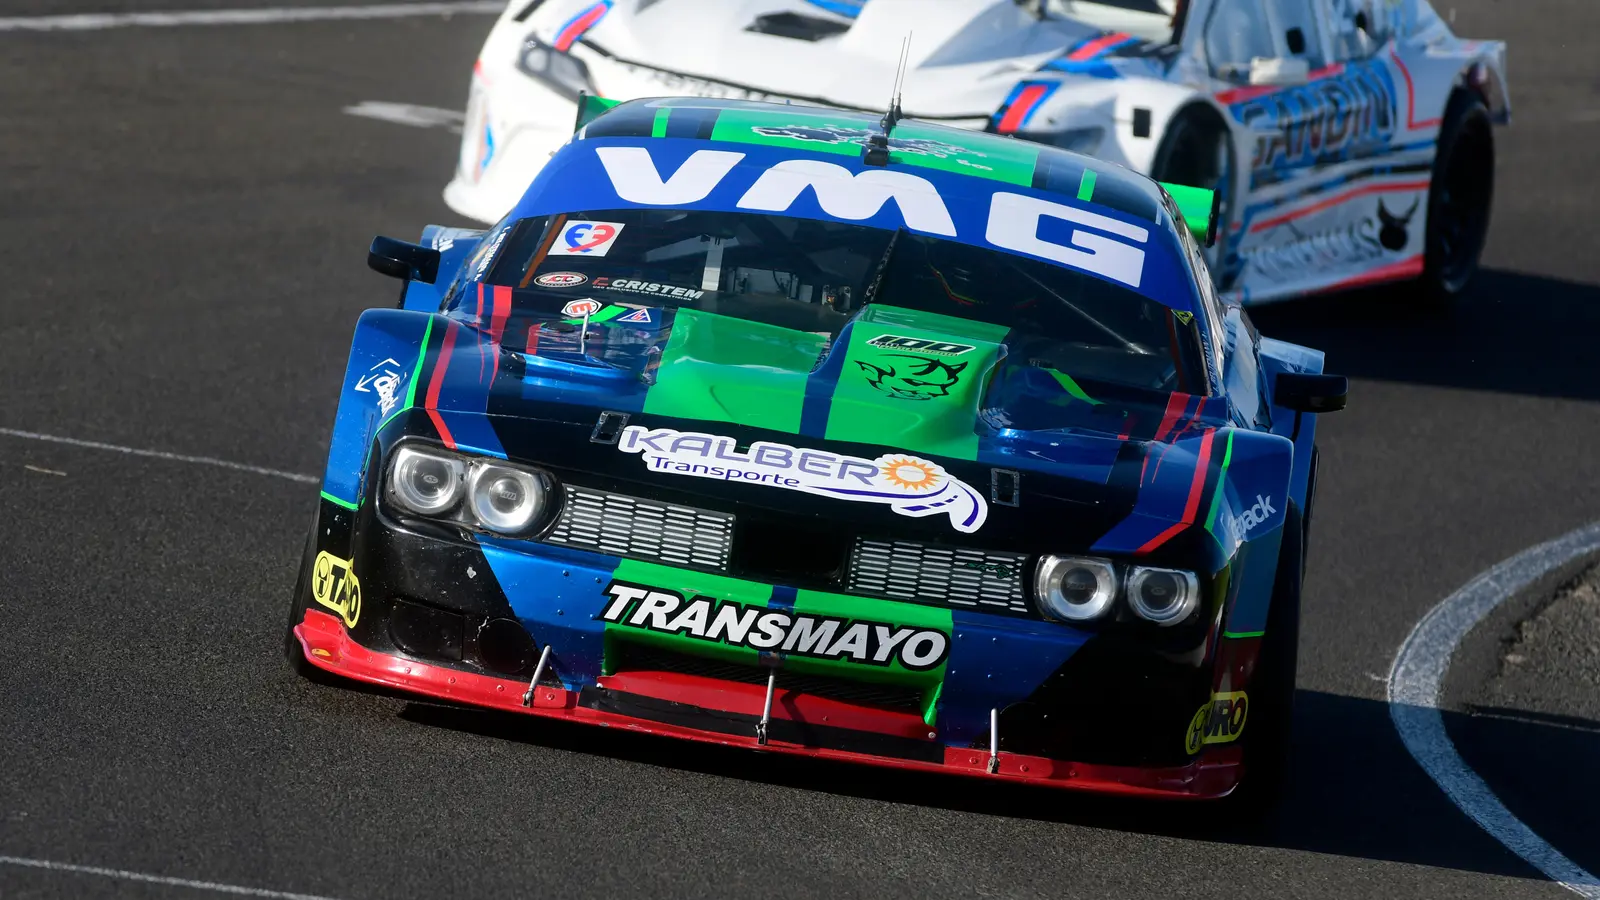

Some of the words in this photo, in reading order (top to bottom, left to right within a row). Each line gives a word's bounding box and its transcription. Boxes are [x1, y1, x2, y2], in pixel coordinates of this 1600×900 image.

[596, 147, 1149, 288] VMG
[612, 279, 704, 299] CRISTEM
[650, 455, 800, 488] Transporte
[603, 584, 946, 667] TRANSMAYO
